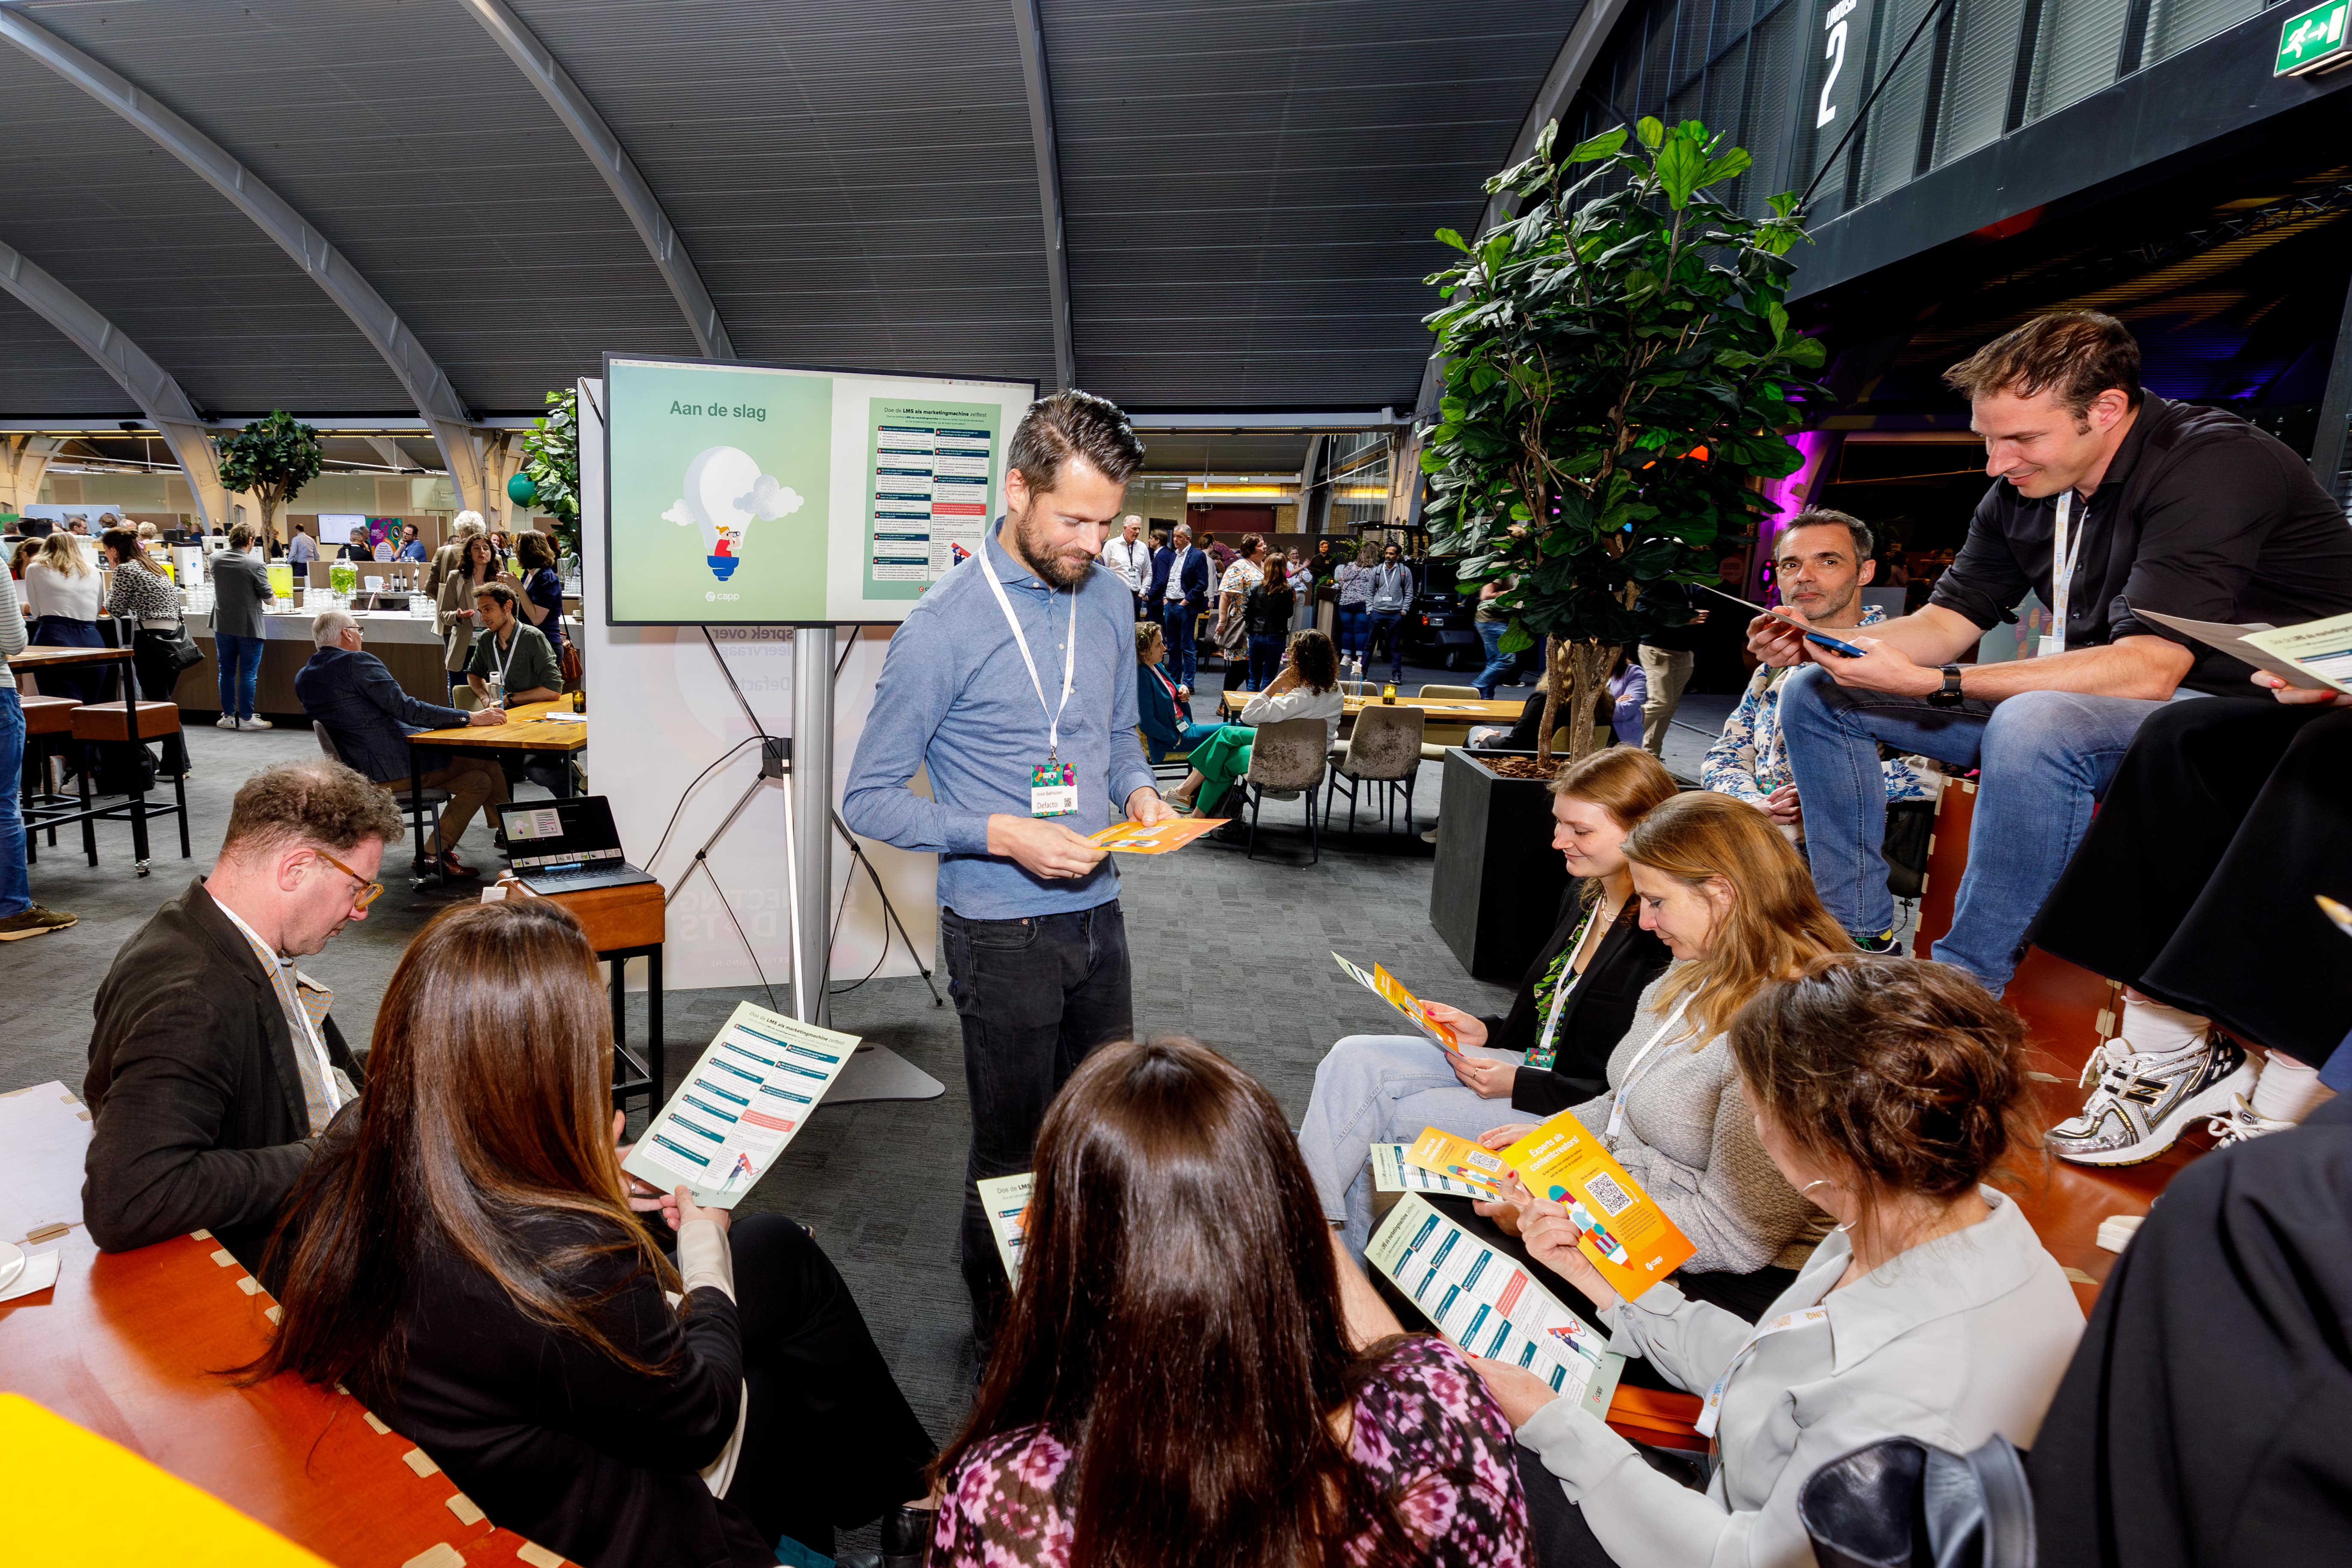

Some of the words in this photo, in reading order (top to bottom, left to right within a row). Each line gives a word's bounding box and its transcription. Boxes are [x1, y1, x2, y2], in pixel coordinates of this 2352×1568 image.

[1816, 20, 1848, 129] 2
[670, 400, 702, 416] Aan
[708, 402, 728, 416] de
[733, 404, 766, 422] slag
[717, 593, 739, 602] capp
[786, 1024, 828, 1041] marketingmachine
[1616, 1095, 1625, 1115] LESLINQ
[1528, 1138, 1555, 1158] Experts
[1554, 1133, 1565, 1142] als
[1530, 1135, 1580, 1172] contentcreators!
[1388, 1213, 1408, 1240] marketingmachine
[1651, 1255, 1663, 1266] capp
[1806, 1310, 1829, 1320] LINQ
[1596, 1386, 1604, 1397] capp
[1710, 1382, 1723, 1407] LESLINQ
